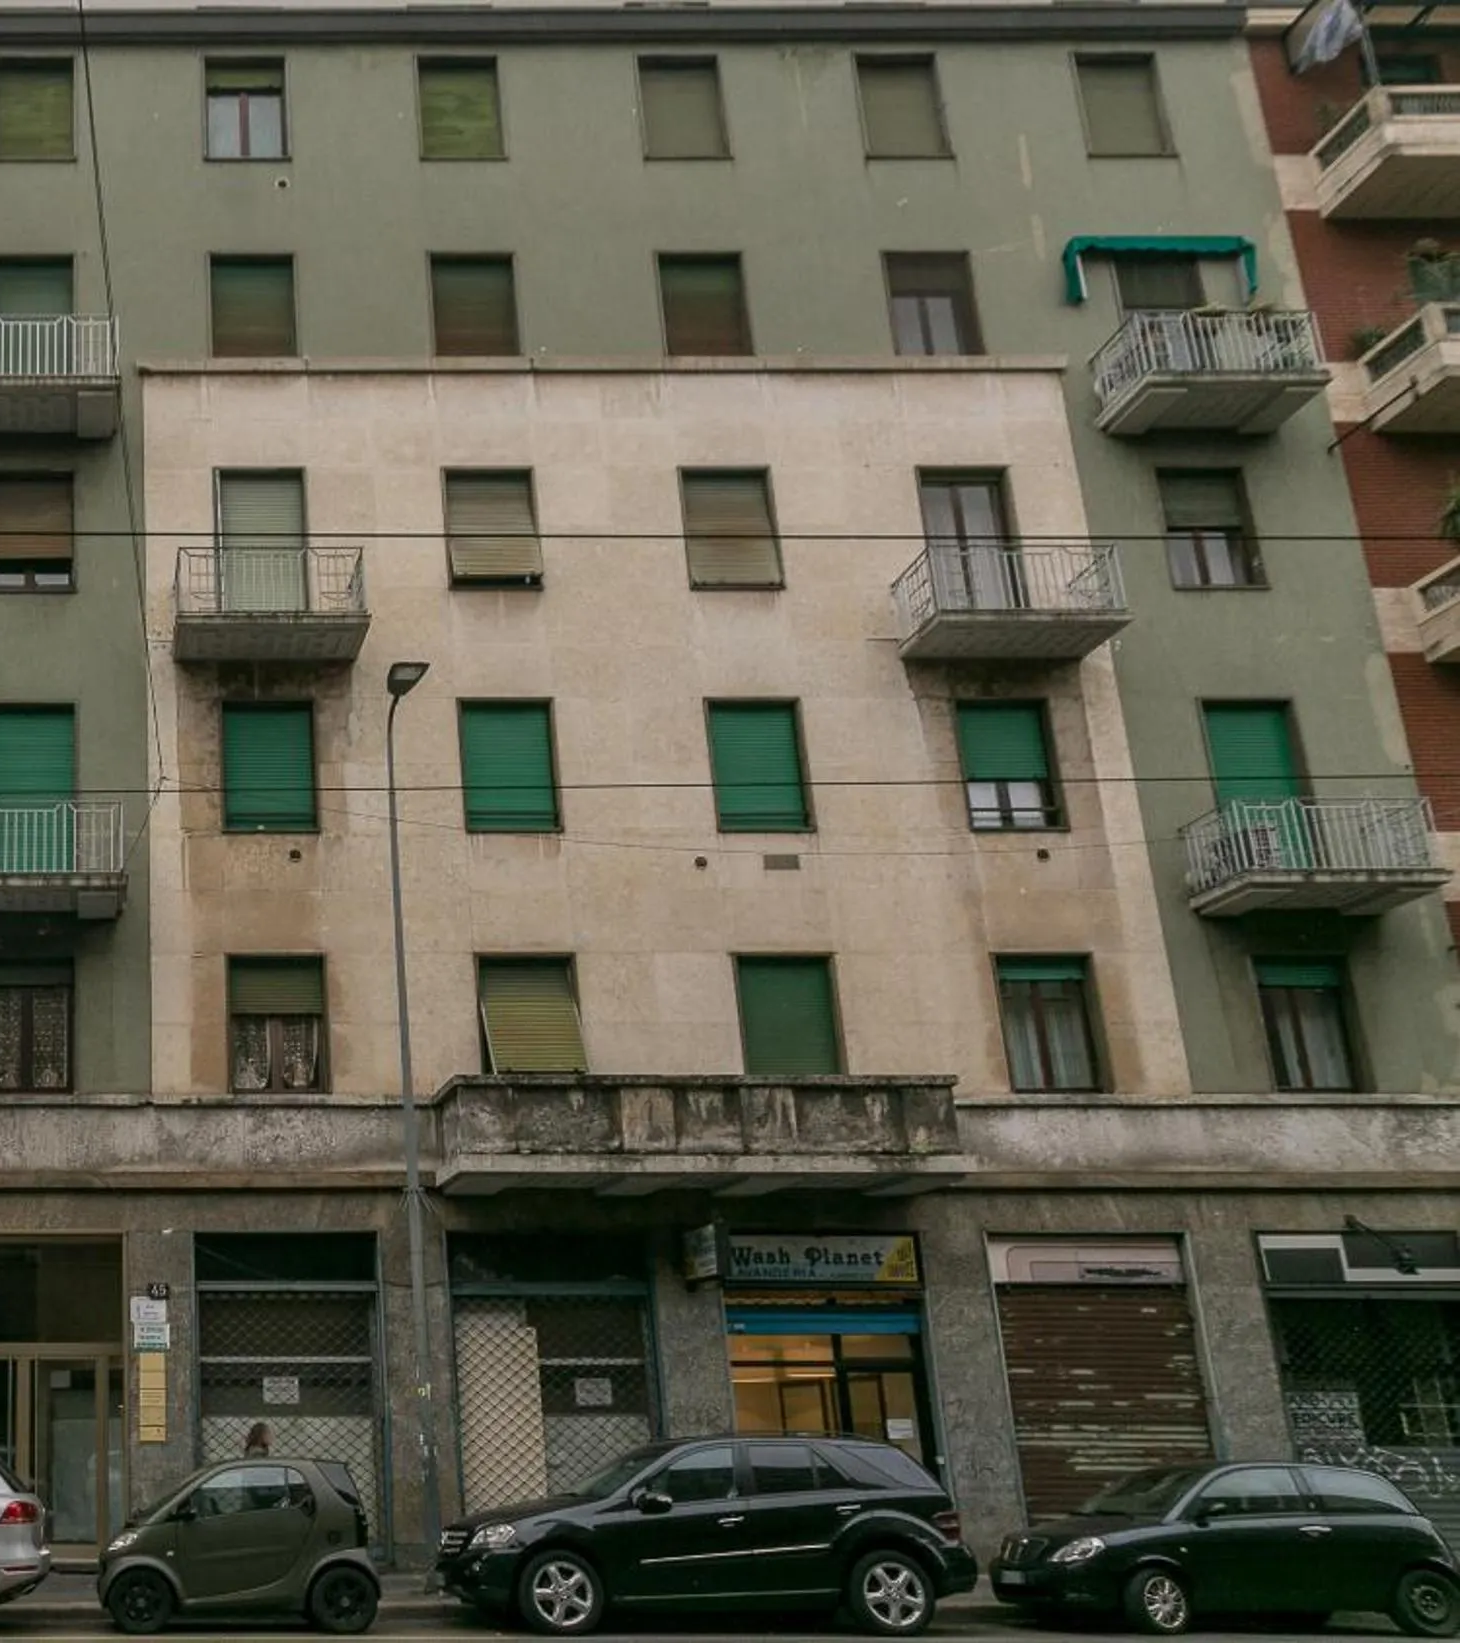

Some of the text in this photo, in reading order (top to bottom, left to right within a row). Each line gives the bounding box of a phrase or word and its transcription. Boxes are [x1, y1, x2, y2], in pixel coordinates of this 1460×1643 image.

[733, 1245, 791, 1267] Wash
[804, 1246, 885, 1267] Planet
[151, 1284, 166, 1297] 45
